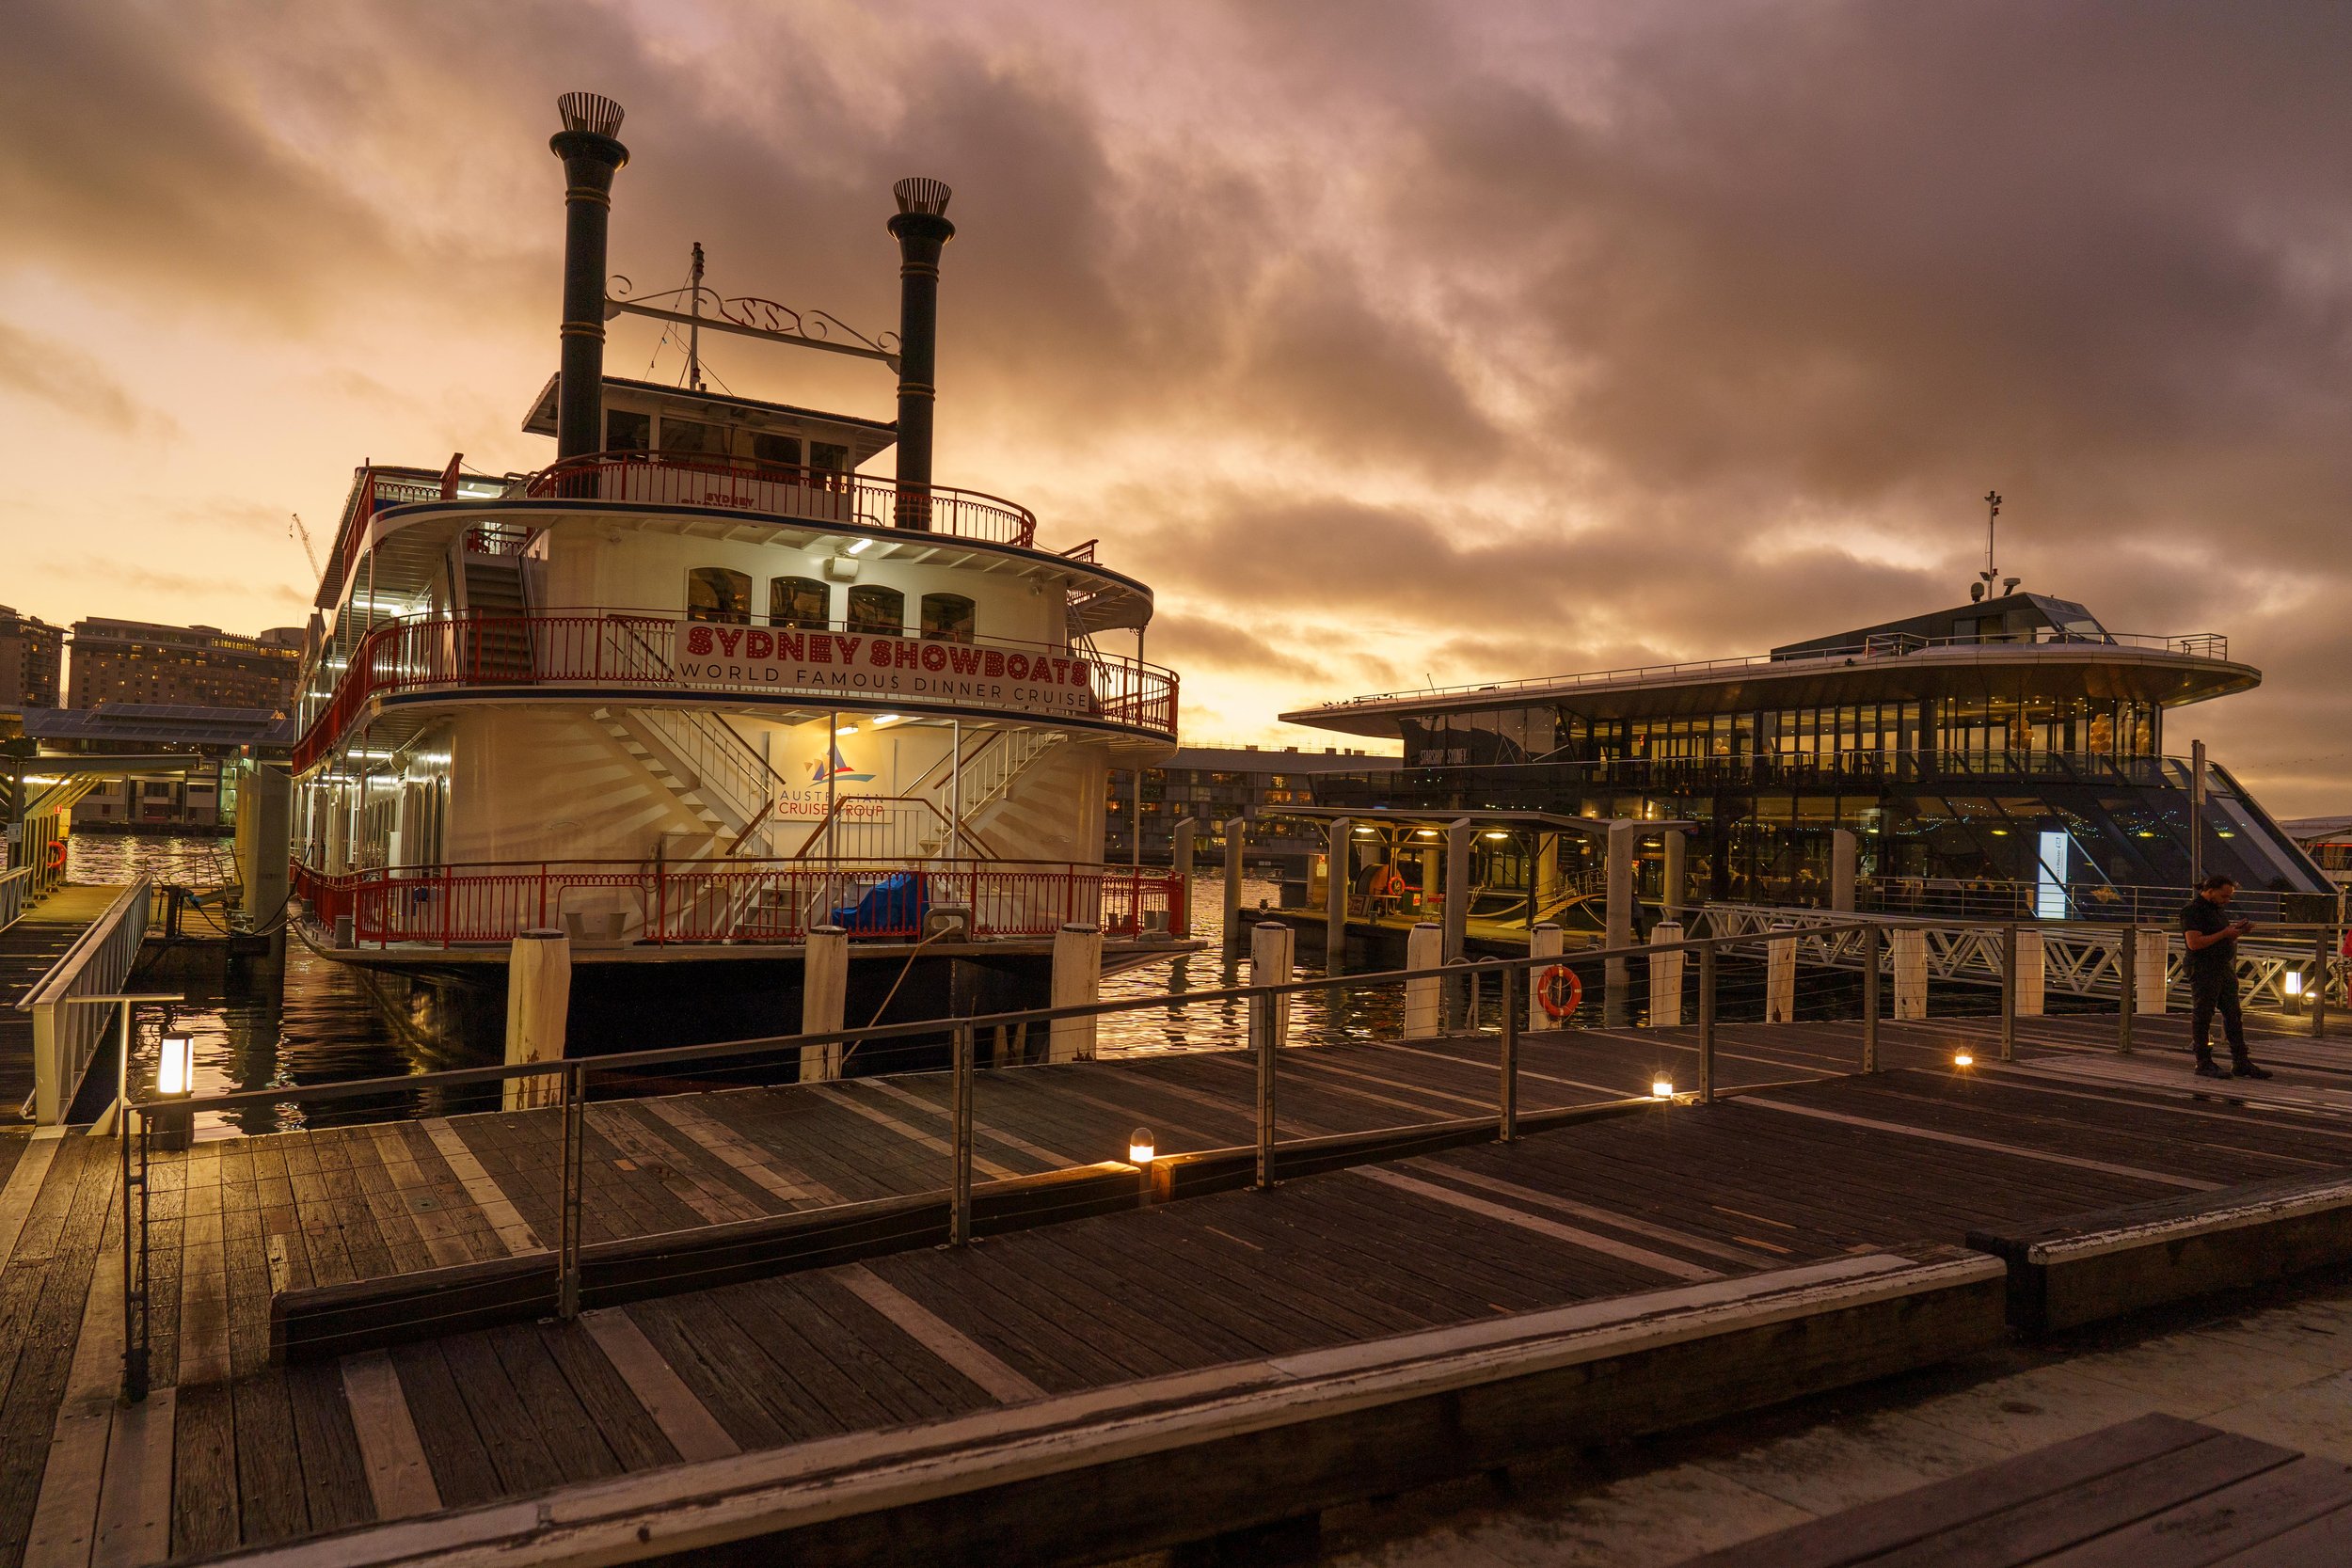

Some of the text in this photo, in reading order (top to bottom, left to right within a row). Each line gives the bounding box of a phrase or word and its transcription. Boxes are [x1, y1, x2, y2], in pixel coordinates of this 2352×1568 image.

[707, 492, 755, 507] SYDNEY
[687, 626, 1088, 688] SYDNEY SHOWBOATS
[680, 662, 1087, 707] WORLD FAMOUS DINNER CRUISE
[1447, 748, 1468, 764] SYDNEY
[779, 801, 884, 817] CRUISE ROUP
